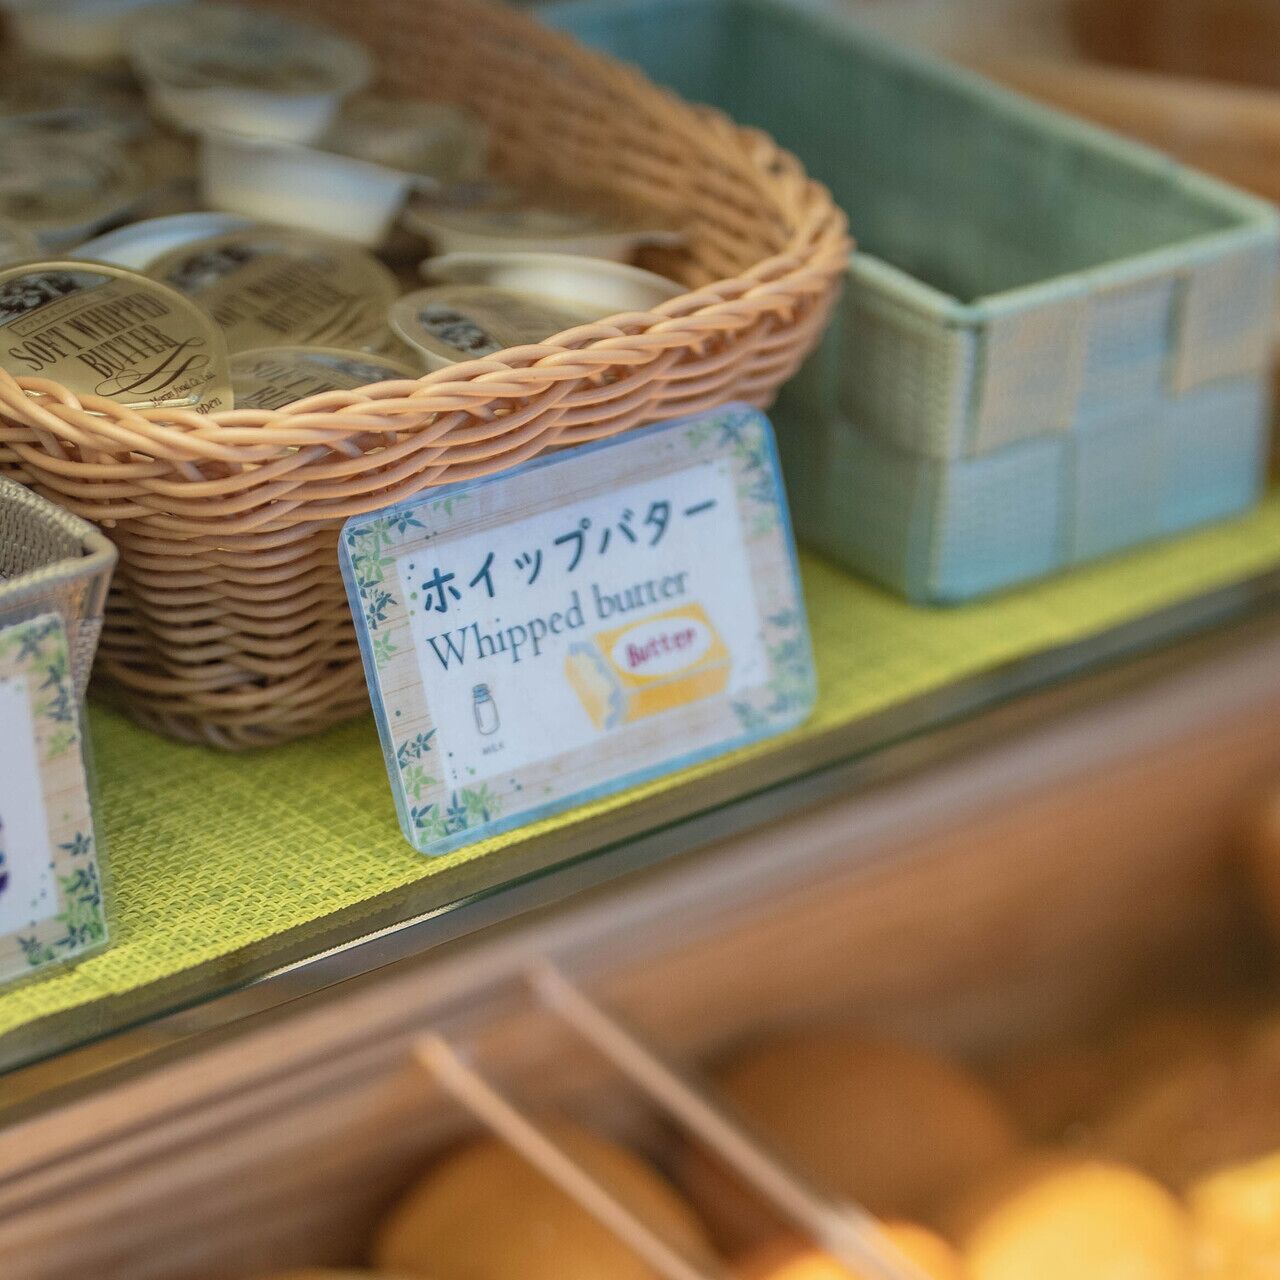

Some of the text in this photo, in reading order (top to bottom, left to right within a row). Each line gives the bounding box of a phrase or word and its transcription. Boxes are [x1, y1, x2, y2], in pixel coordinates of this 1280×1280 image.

[8, 326, 83, 372] SOFT
[63, 292, 172, 343] WHIPPED
[75, 323, 180, 379] BUTTER
[196, 397, 222, 415] open
[421, 500, 717, 614] ホイップバター
[426, 570, 690, 672] Whipped butter
[624, 627, 698, 668] Butter
